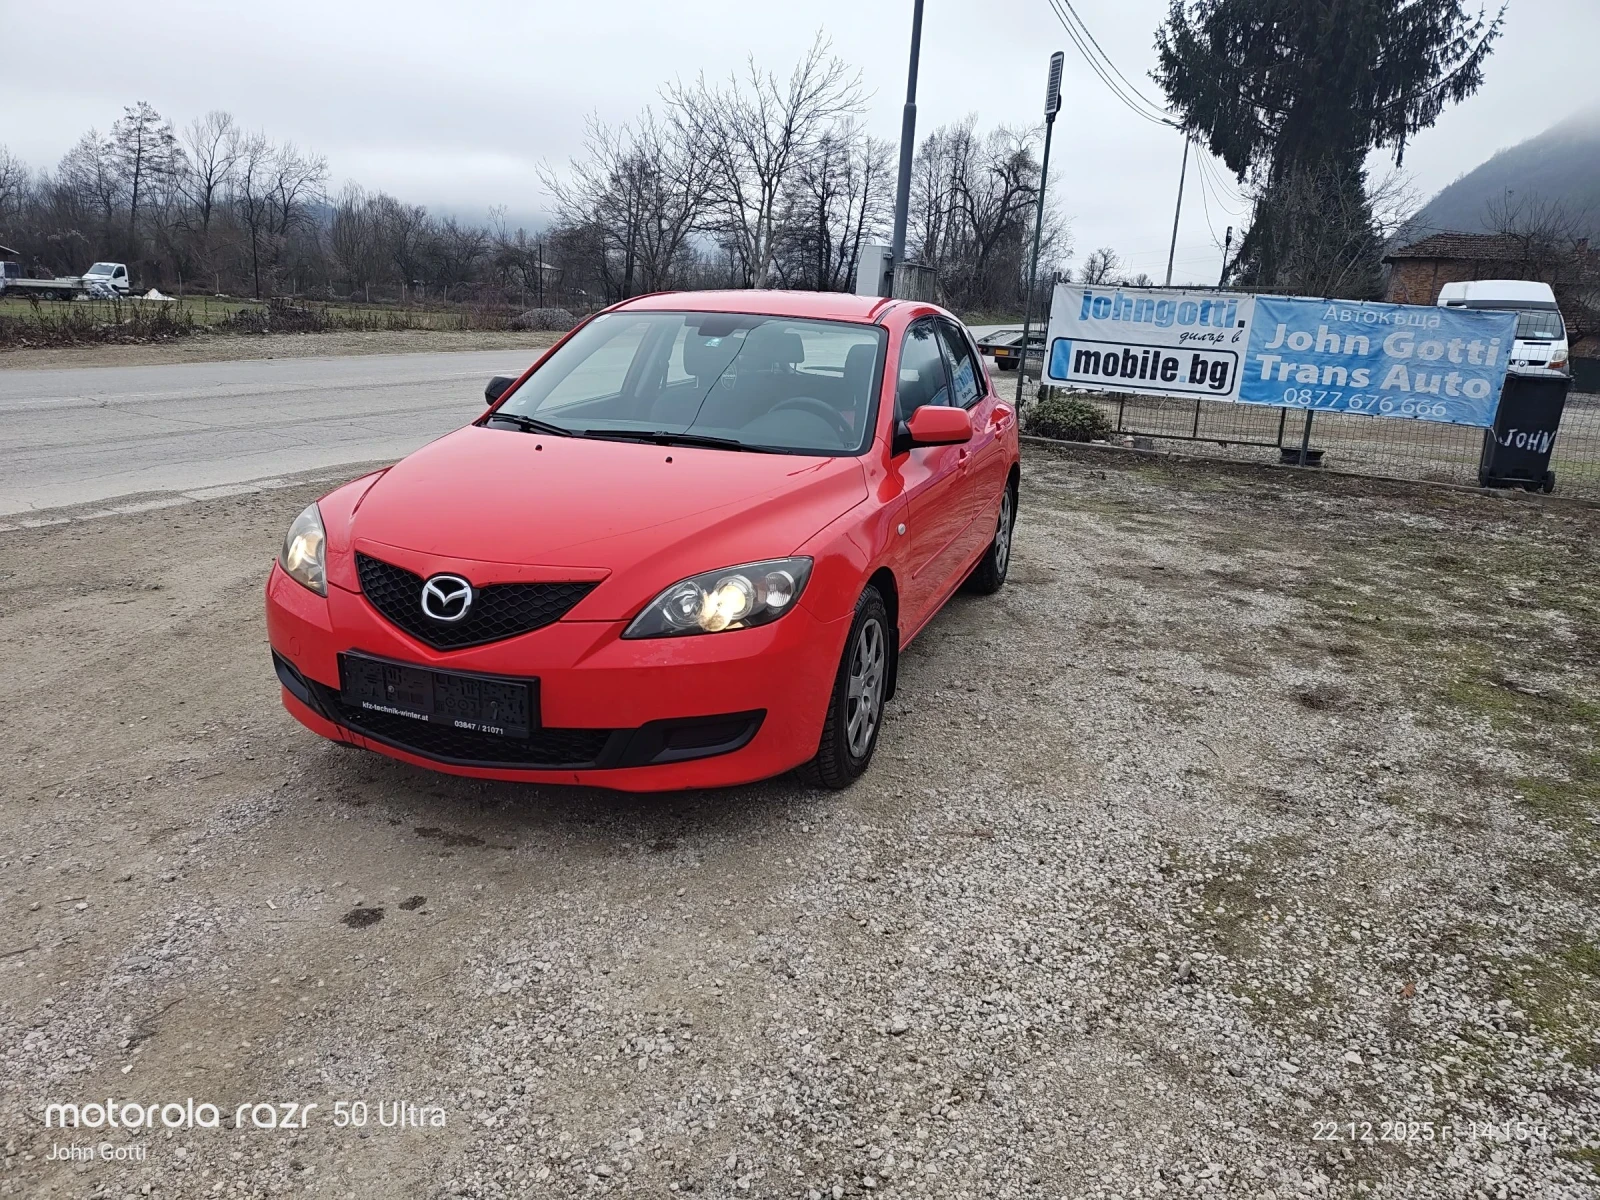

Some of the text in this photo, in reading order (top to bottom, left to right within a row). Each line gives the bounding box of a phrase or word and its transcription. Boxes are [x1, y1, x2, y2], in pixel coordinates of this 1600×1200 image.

[1323, 305, 1441, 329] Автокъща
[1265, 323, 1501, 367] John Gotti
[1073, 348, 1229, 390] mobile.bg
[1256, 354, 1491, 399] Trans Auto
[1283, 387, 1447, 417] 0877 676 666
[1498, 429, 1556, 453] JOHN
[362, 701, 429, 721] kfz-technik-winter.at
[482, 725, 504, 735] 21071
